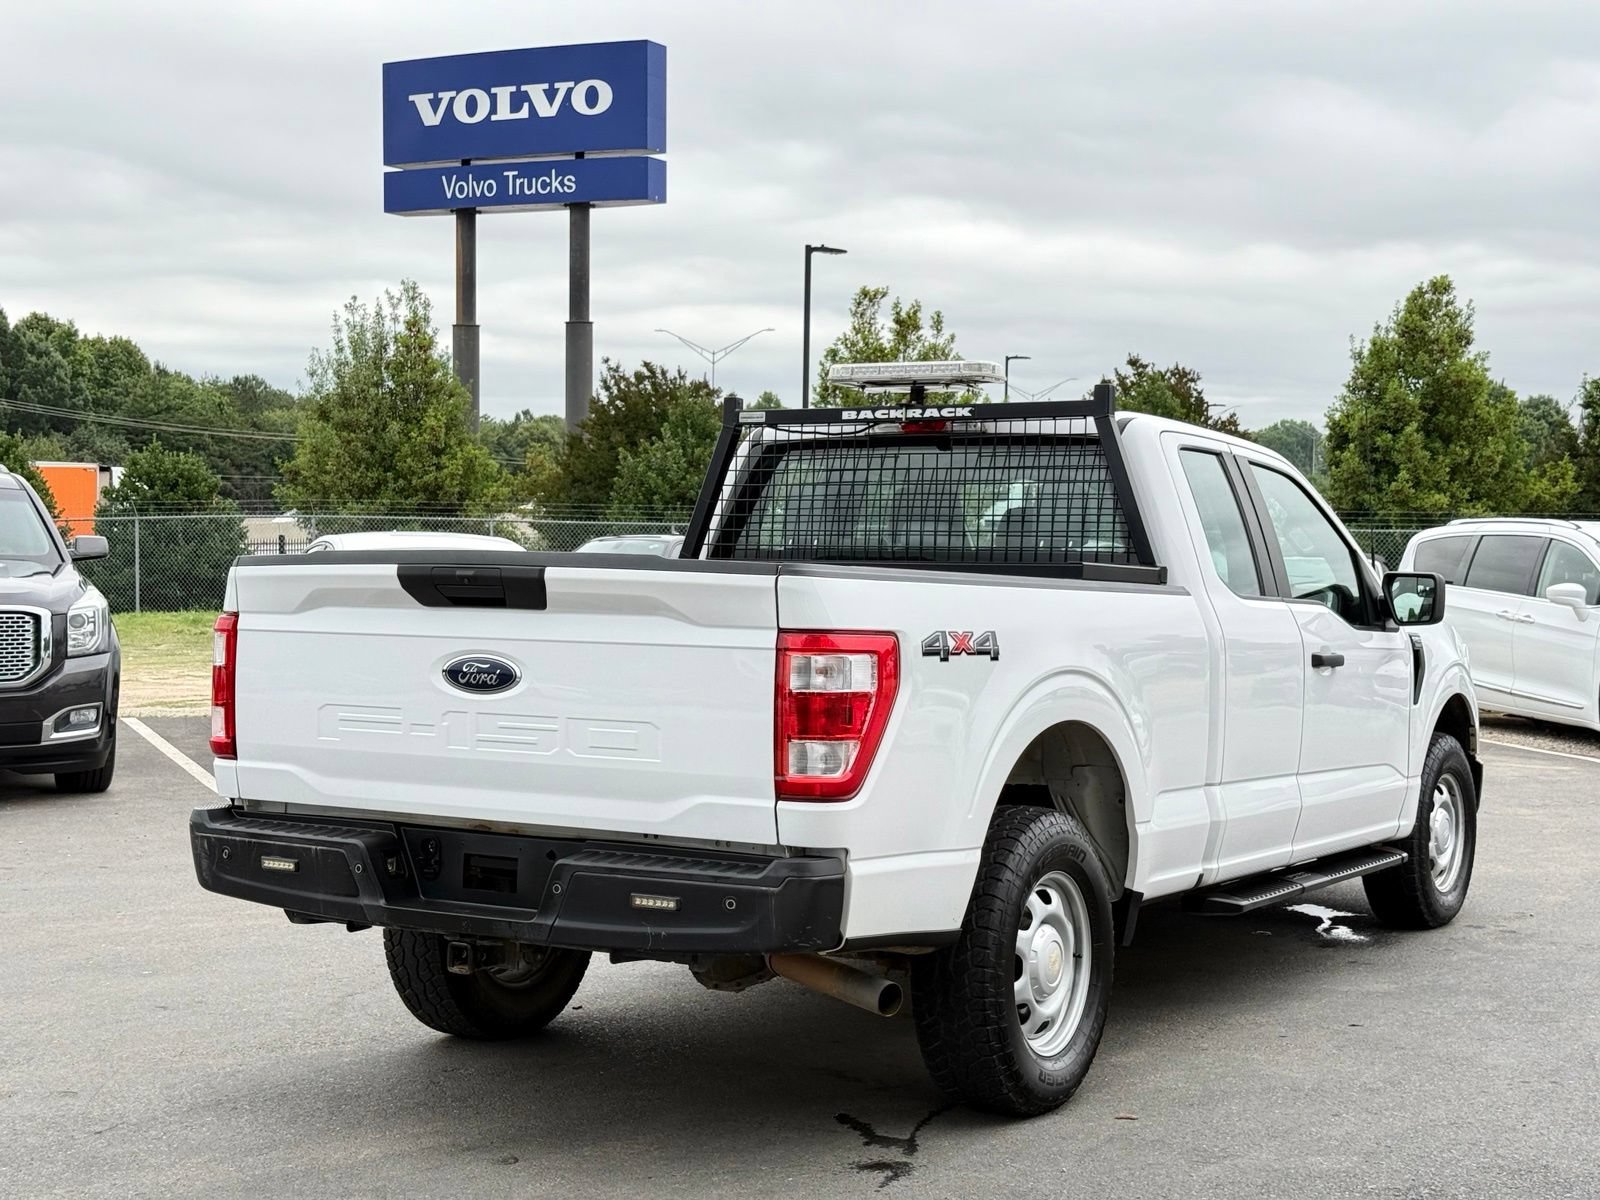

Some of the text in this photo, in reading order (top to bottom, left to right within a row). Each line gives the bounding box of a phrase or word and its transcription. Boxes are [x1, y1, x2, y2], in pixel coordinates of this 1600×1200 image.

[408, 79, 613, 127] VOLVO
[441, 165, 577, 200] Volvo Trucks
[841, 407, 973, 420] BACKRACK
[458, 662, 501, 685] Ford
[317, 703, 662, 762] F-150
